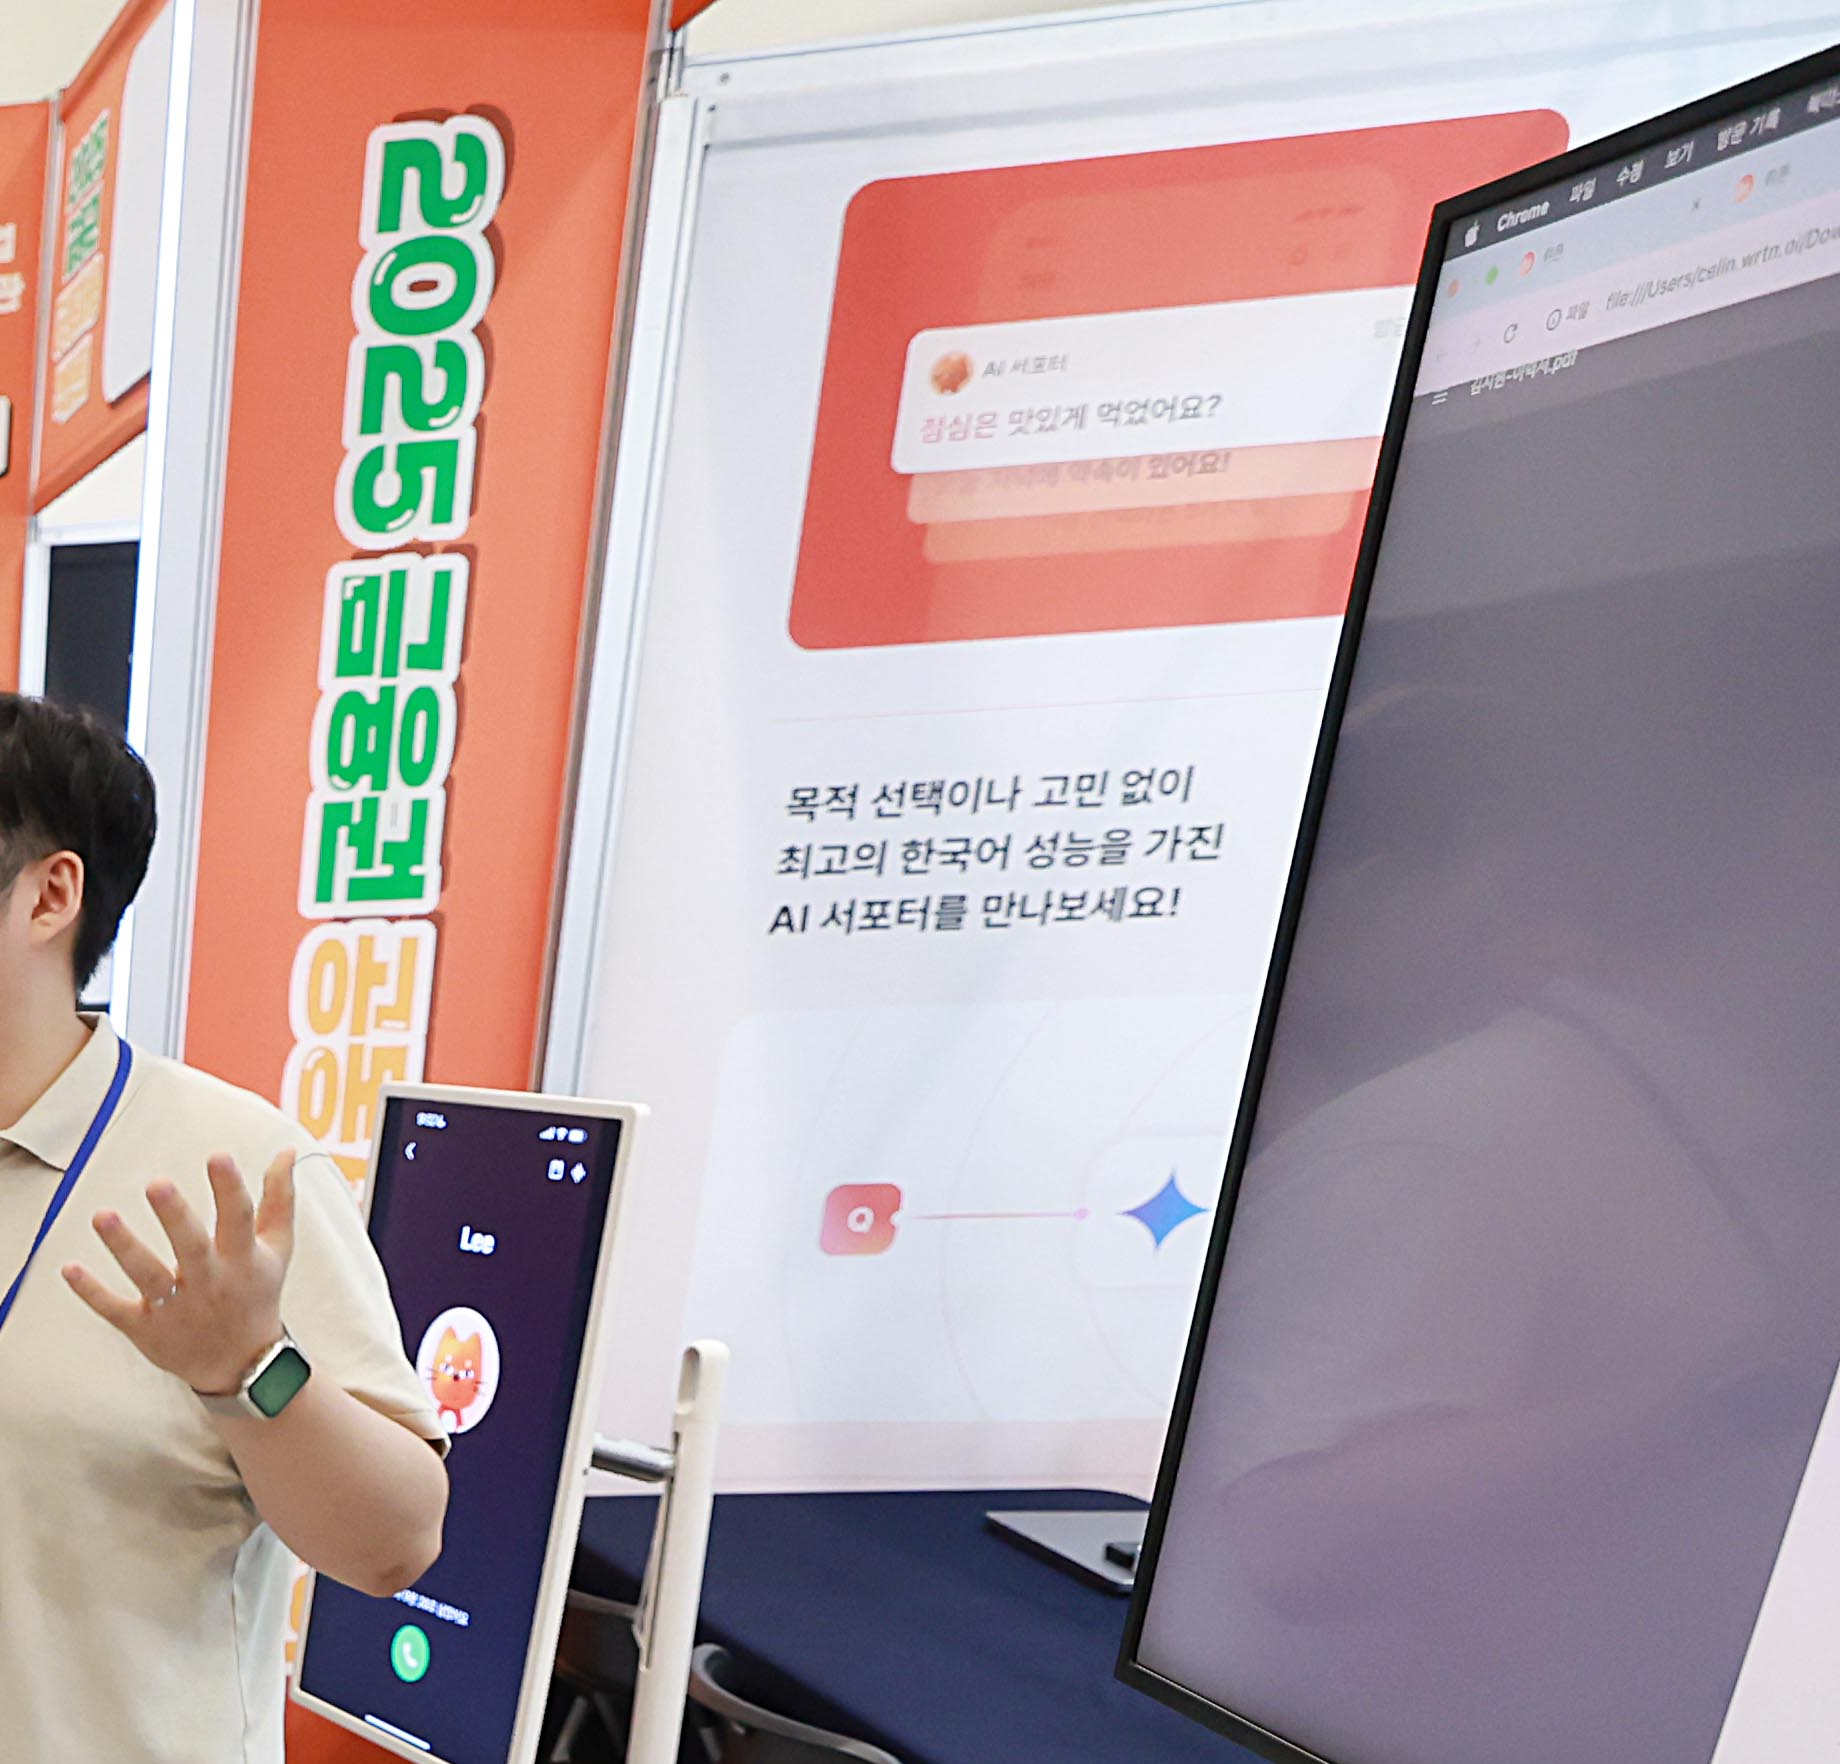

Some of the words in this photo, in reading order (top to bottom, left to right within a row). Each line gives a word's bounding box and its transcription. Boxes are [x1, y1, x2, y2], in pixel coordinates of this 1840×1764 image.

[1497, 201, 1550, 232] Chrome
[1569, 177, 1597, 203] 파일
[1664, 140, 1695, 169] 보기
[350, 130, 492, 534] 2025
[981, 360, 1006, 378] AI
[1009, 354, 1068, 376] 서포터
[920, 410, 999, 444] 점심은
[1008, 402, 1088, 437] 맛있게
[1096, 393, 1223, 428] 먹었어요?
[314, 566, 453, 906] 금융권
[786, 783, 860, 822] 목적
[871, 774, 1022, 820] 선택이나
[1033, 770, 1110, 809] 고민
[1120, 764, 1196, 806] 없이
[776, 839, 888, 881] 최고의
[901, 833, 1012, 873] 한국어
[1025, 828, 1133, 868] 성능을
[1144, 822, 1226, 863] 가진
[767, 904, 811, 935] AI
[821, 894, 968, 935] 서포터를
[981, 885, 1182, 928] 만나보세요!
[296, 932, 419, 1182] 공동
[459, 1225, 495, 1255] Lee
